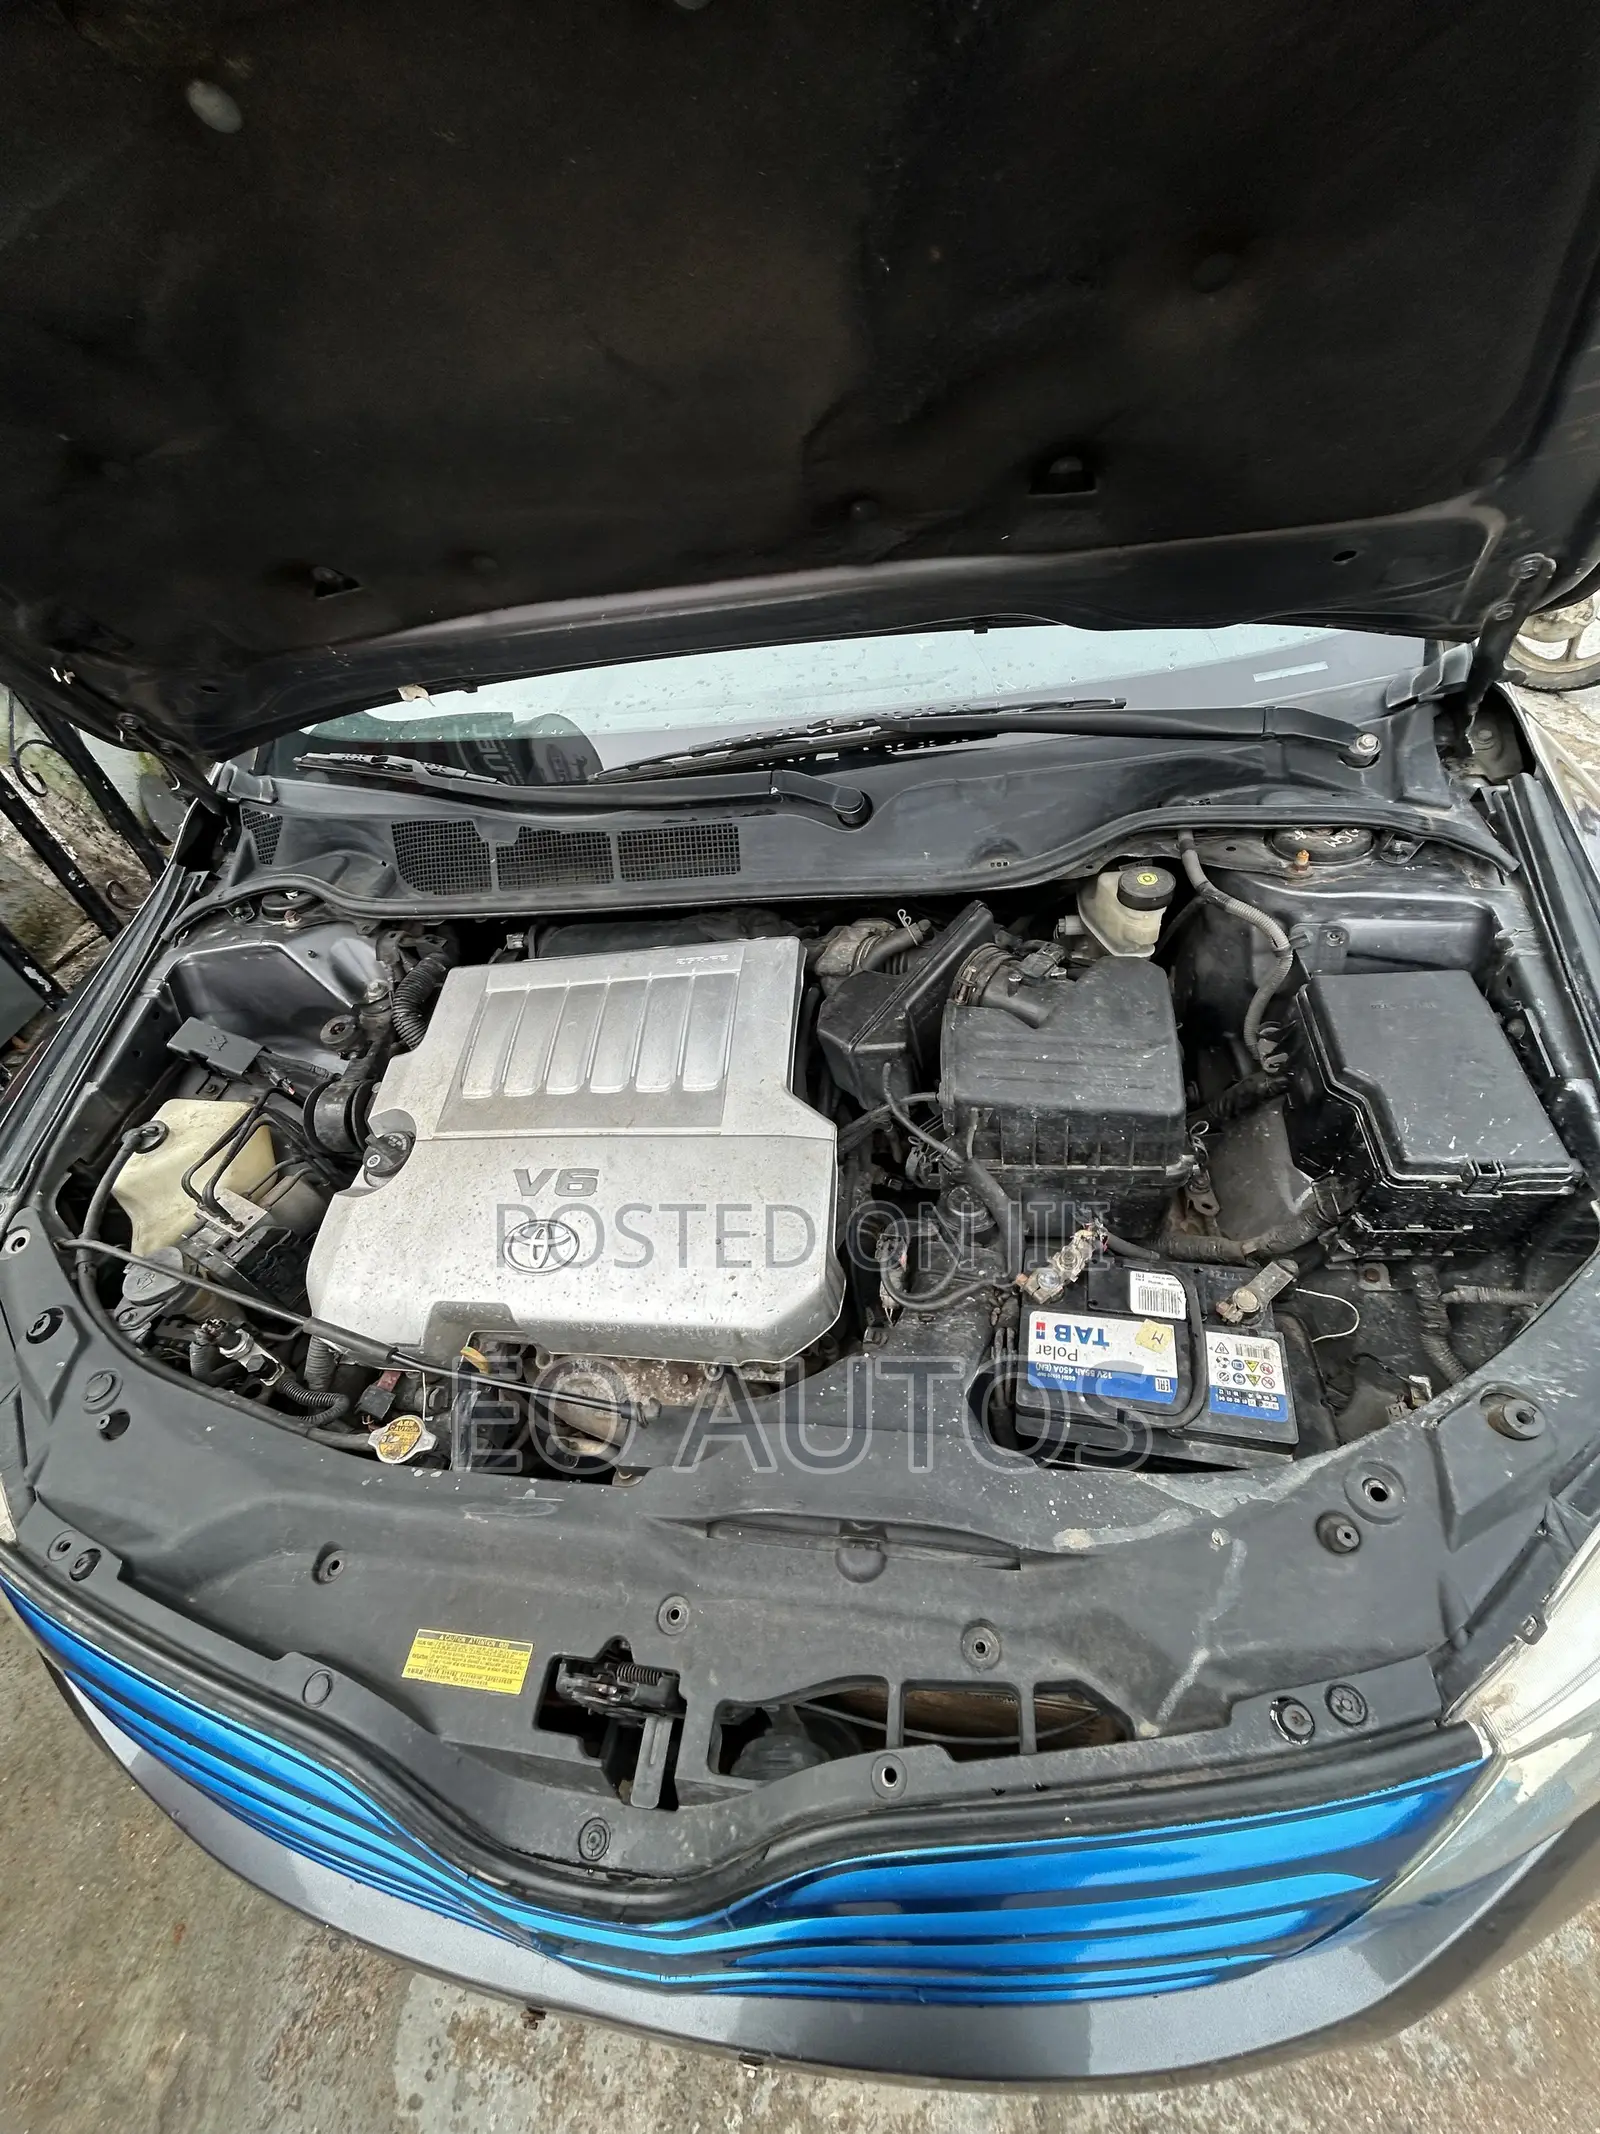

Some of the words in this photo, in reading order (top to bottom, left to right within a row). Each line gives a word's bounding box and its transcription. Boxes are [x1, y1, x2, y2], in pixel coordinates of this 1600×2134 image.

[512, 1168, 600, 1197] V6
[1054, 1324, 1109, 1347] TAB
[1036, 1344, 1078, 1361] Polar
[1035, 1361, 1052, 1373] (EN)
[1053, 1364, 1074, 1374] 450A
[1074, 1367, 1096, 1377] 55Ah
[1096, 1370, 1113, 1380] 12V
